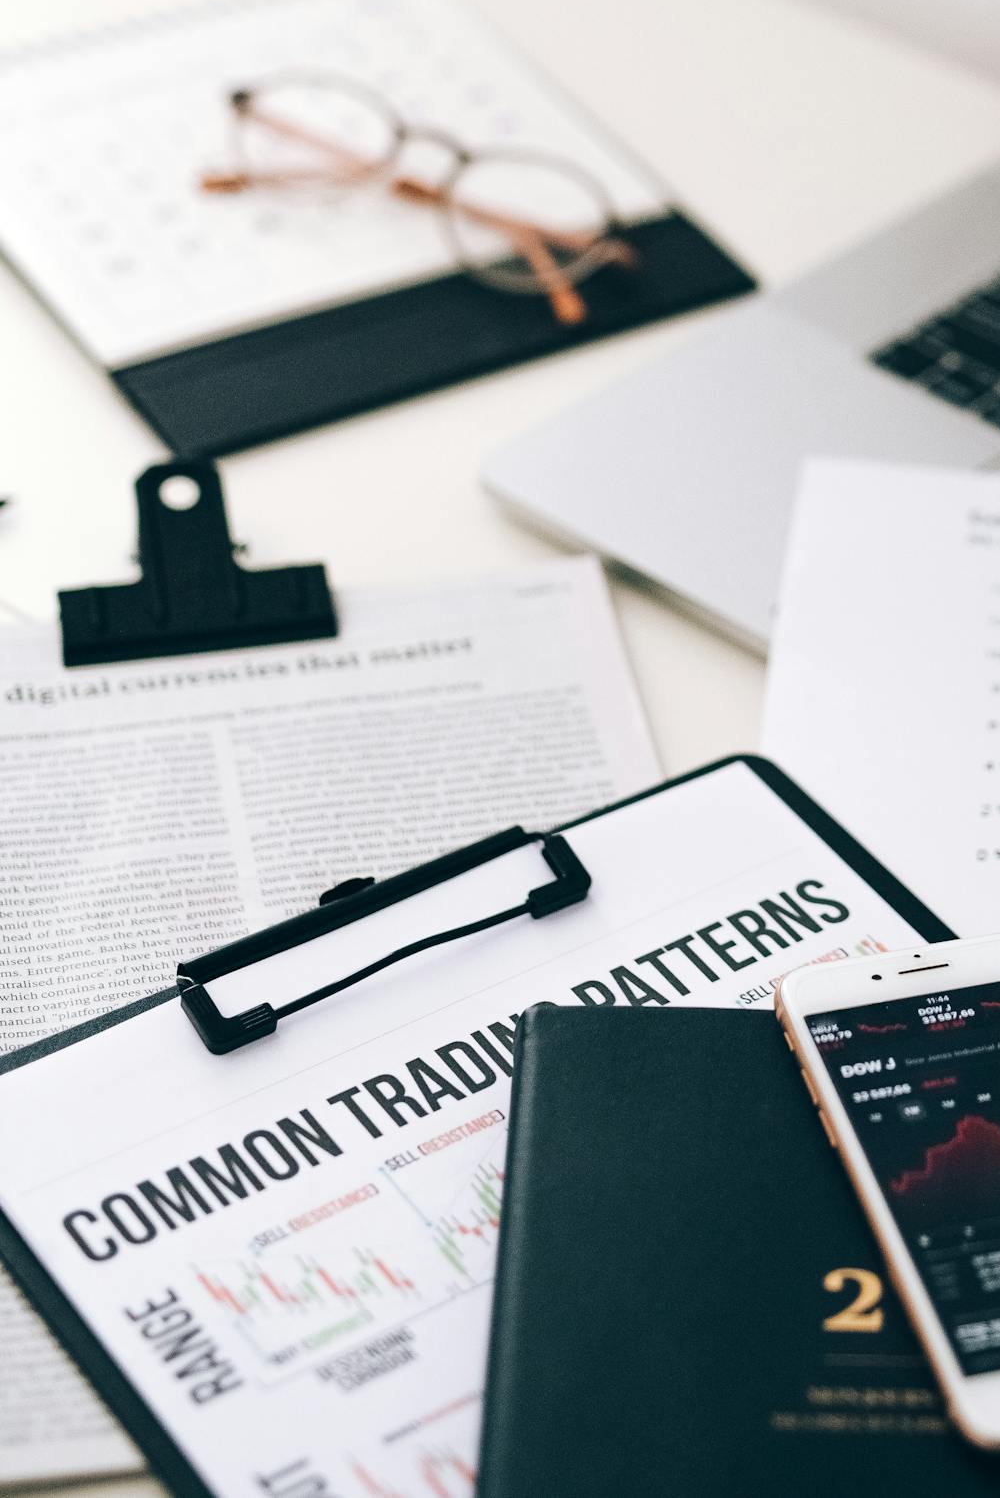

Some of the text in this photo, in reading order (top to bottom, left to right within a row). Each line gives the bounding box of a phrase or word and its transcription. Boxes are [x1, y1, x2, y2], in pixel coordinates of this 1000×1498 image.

[7, 635, 475, 706] digital currencies that matter
[16, 905, 59, 918] treated
[56, 911, 114, 924] wreckage
[134, 902, 184, 915] Lehman
[3, 933, 32, 943] head
[55, 927, 76, 937] the
[80, 918, 125, 933] Federal
[186, 904, 246, 922] grumbled
[14, 939, 85, 954] innovation
[87, 935, 111, 944] was
[113, 931, 132, 940] the
[168, 921, 201, 934] Since
[204, 920, 224, 930] the
[37, 954, 53, 963] its
[100, 942, 137, 954] Banks
[142, 938, 171, 948] have
[176, 928, 249, 945] modernised
[27, 958, 118, 977] Entrepreneurs
[121, 952, 151, 962] have
[155, 948, 184, 959] built
[130, 959, 171, 973] which
[0, 992, 38, 1002] which
[41, 984, 97, 998] contains
[108, 978, 132, 989] riot
[27, 1002, 40, 1013] to
[42, 998, 90, 1011] varying
[92, 989, 140, 1005] degrees
[739, 985, 773, 1005] SELL
[926, 994, 950, 1005] 11:44
[917, 1004, 943, 1018] DOW
[62, 1104, 345, 1265] COMMON
[328, 1013, 519, 1141] TRADIN
[571, 876, 852, 1008] PATTERNS
[840, 1057, 897, 1079] DOW J
[384, 1150, 420, 1171] SELL
[253, 1225, 289, 1247] SELL
[123, 1287, 246, 1408] RANGE
